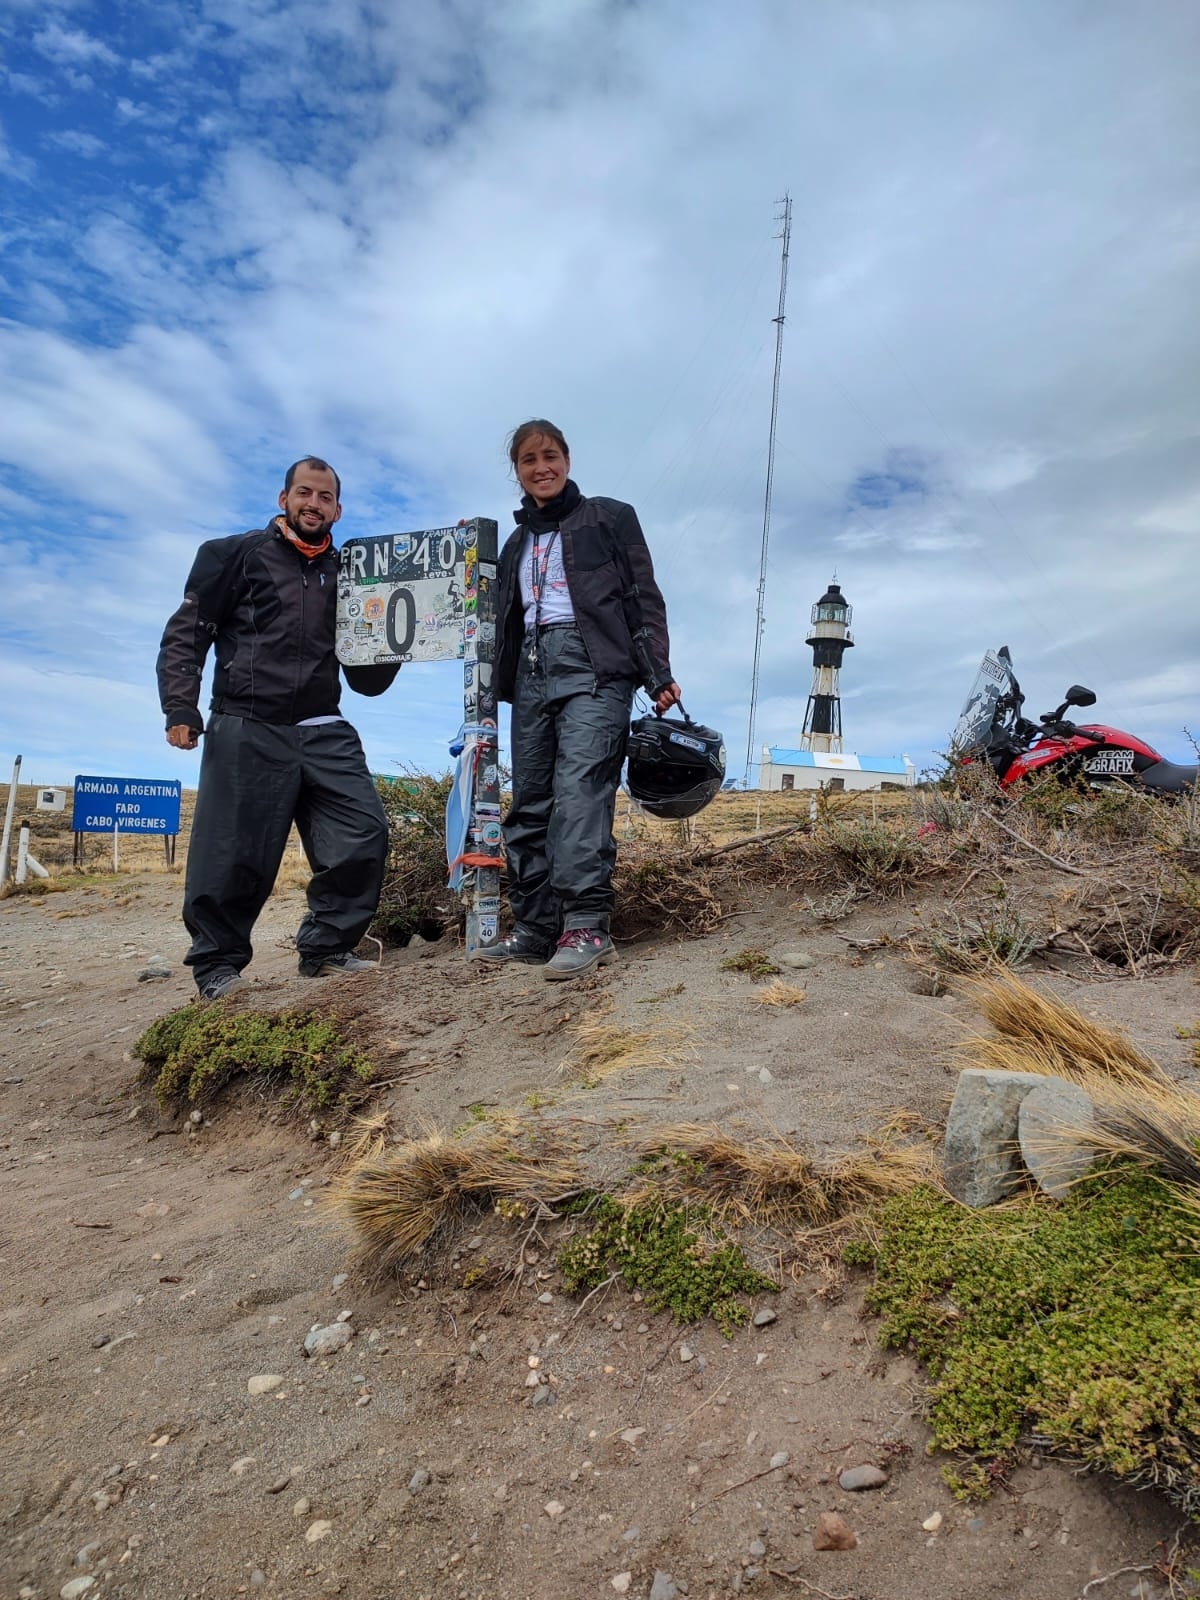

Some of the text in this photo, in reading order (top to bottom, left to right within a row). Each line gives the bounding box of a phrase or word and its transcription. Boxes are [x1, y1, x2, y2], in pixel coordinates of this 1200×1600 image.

[350, 542, 389, 579] RN
[412, 535, 456, 571] 40
[387, 588, 416, 654] 0
[1098, 750, 1134, 759] TEAM
[1095, 759, 1133, 772] GRAFIX
[77, 782, 178, 798] ARMADA ARGENTINA
[115, 803, 140, 814] FARO
[86, 816, 166, 829] CABO VIRGENES
